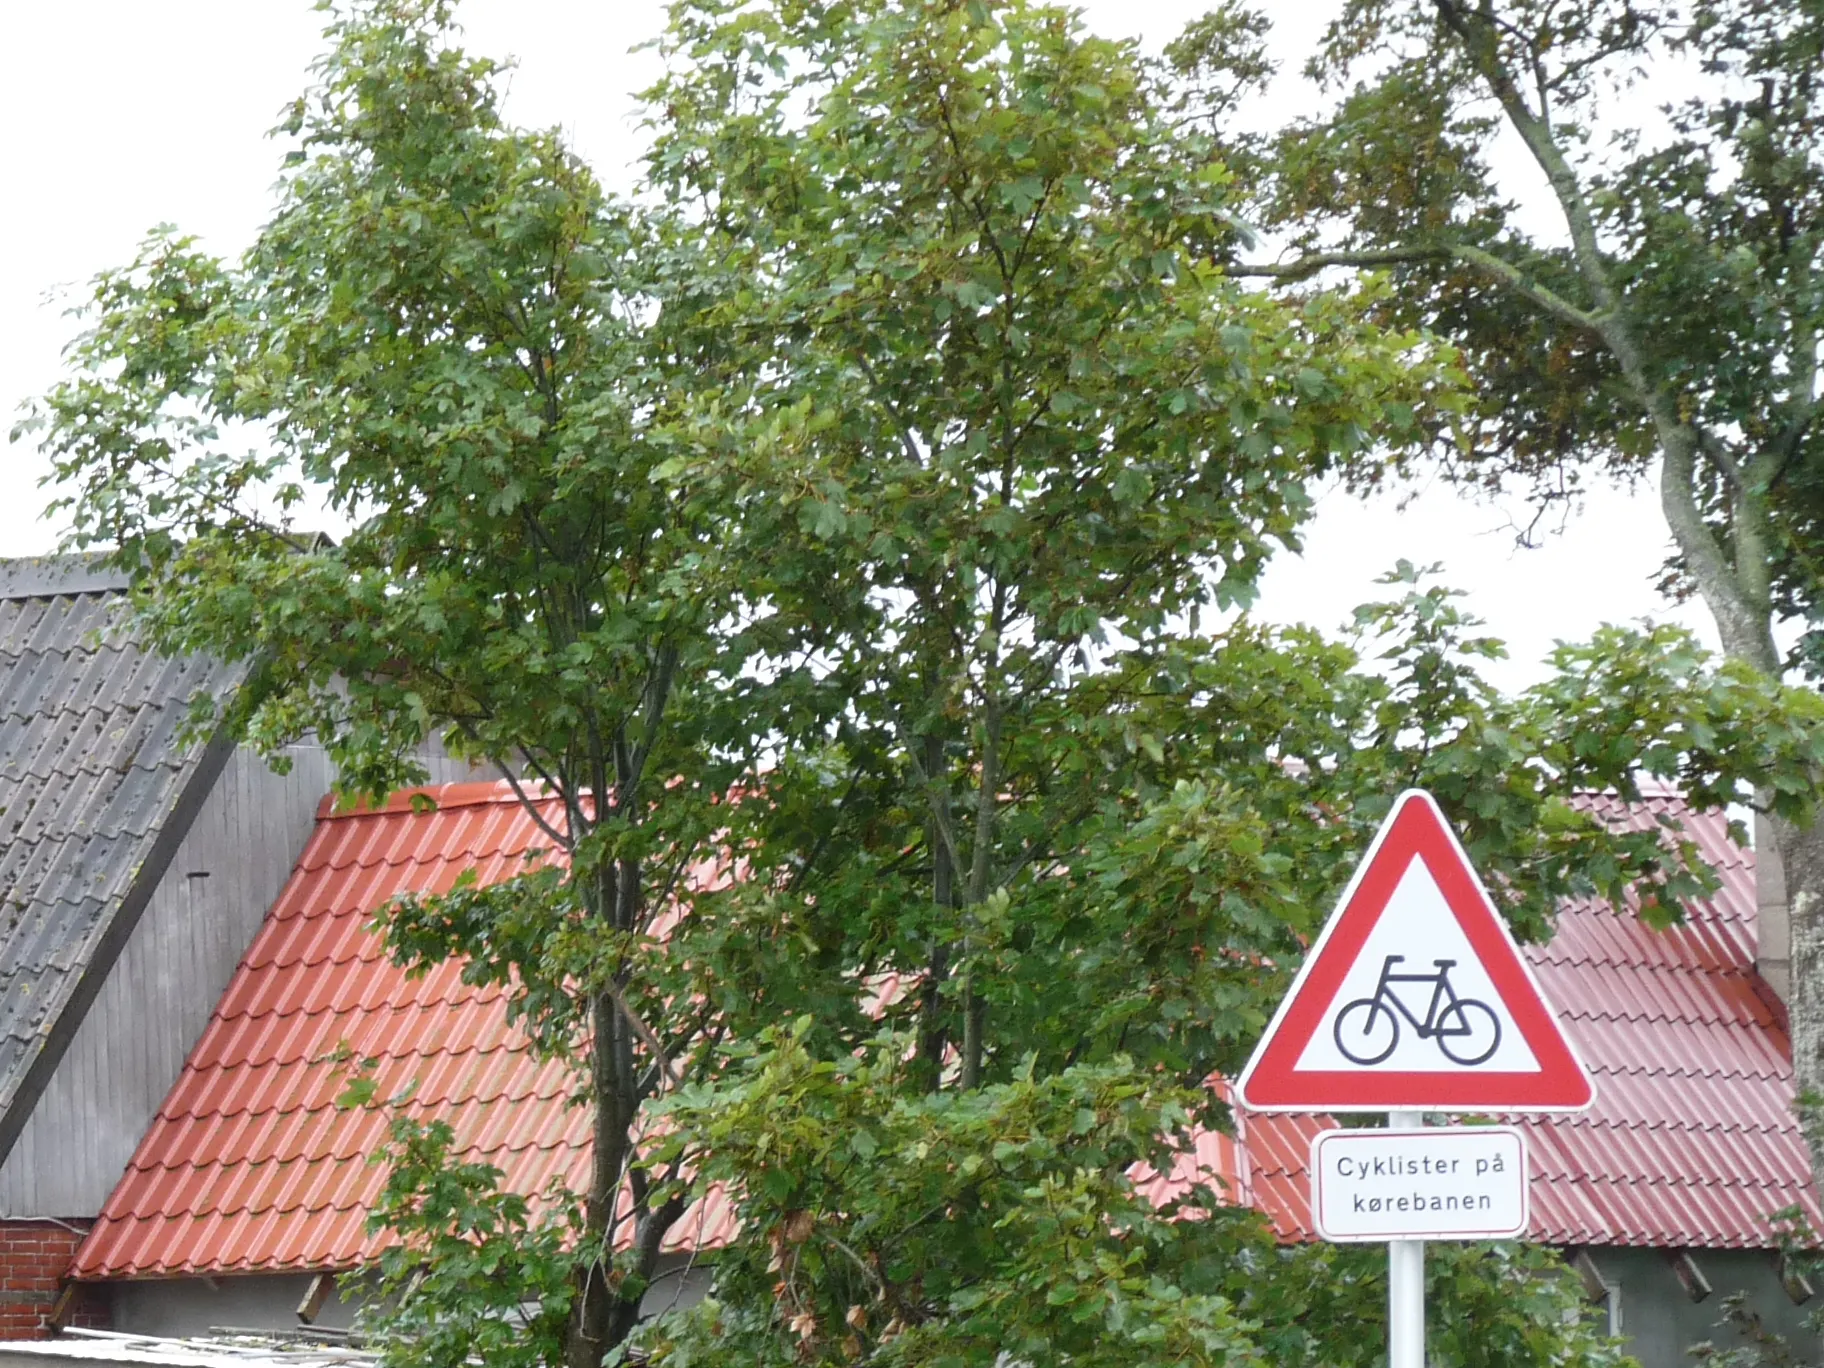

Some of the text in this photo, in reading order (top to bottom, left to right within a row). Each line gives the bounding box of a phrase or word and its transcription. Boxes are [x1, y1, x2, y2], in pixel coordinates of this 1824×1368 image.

[1337, 1153, 1505, 1180] Cyklister på
[1353, 1192, 1491, 1213] kørebanen
